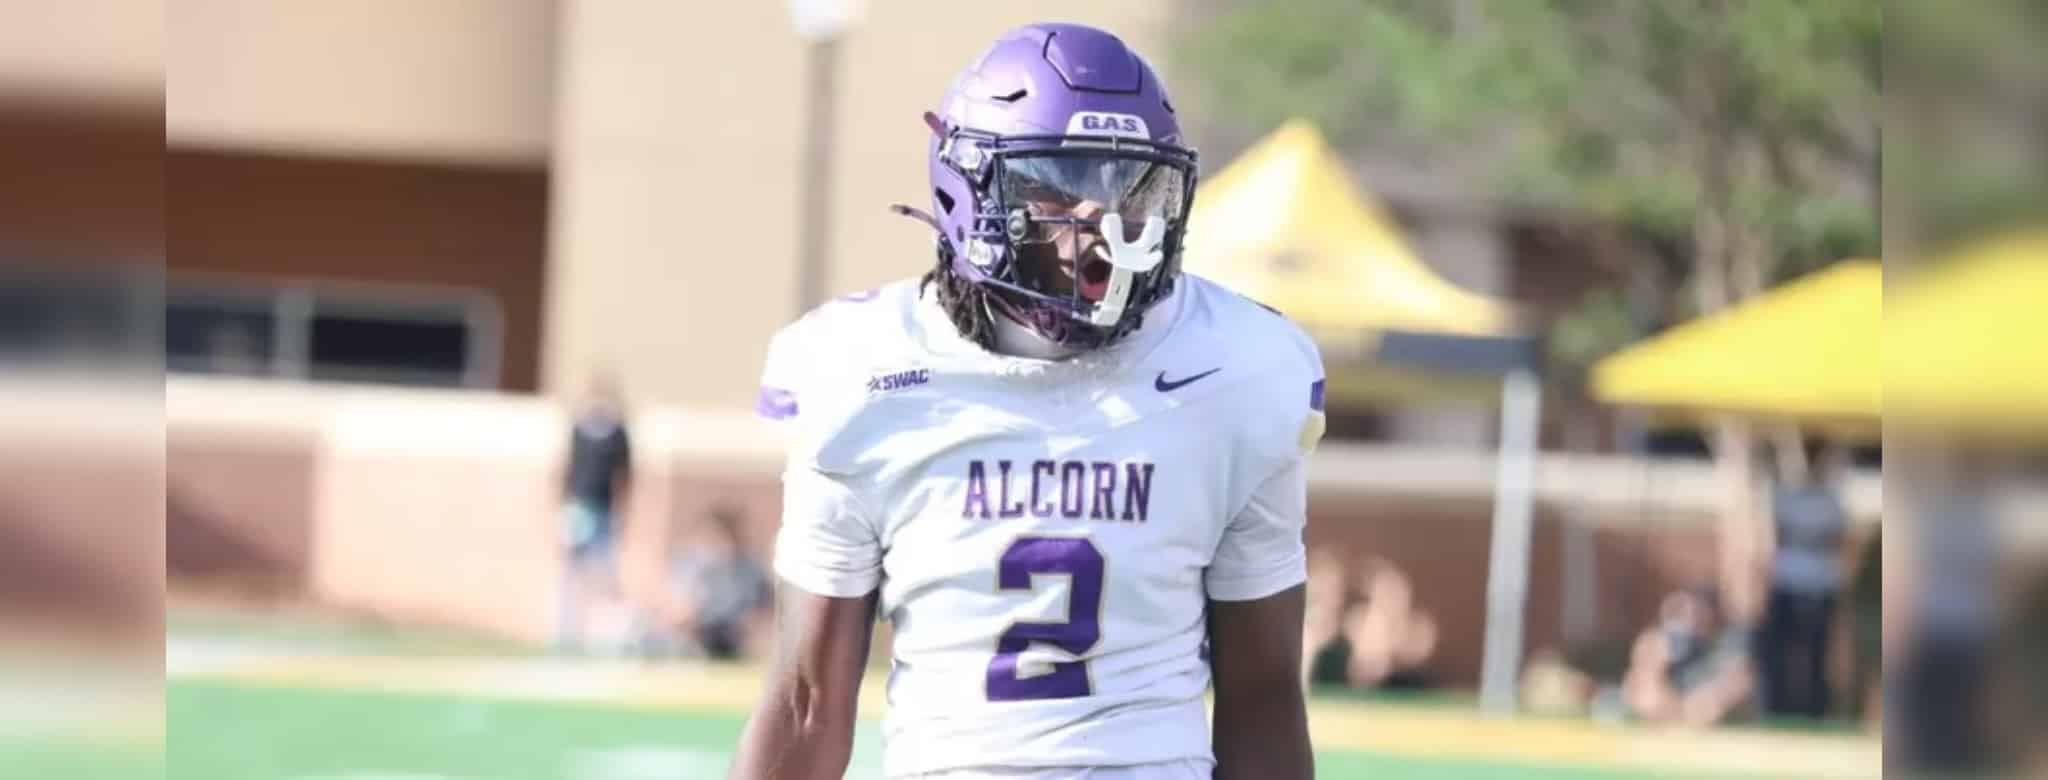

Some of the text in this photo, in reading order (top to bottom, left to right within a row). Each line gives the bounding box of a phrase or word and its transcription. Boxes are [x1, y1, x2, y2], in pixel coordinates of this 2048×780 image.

[882, 368, 929, 391] SWAC
[962, 460, 1154, 522] ALCORN
[985, 536, 1105, 701] 2
